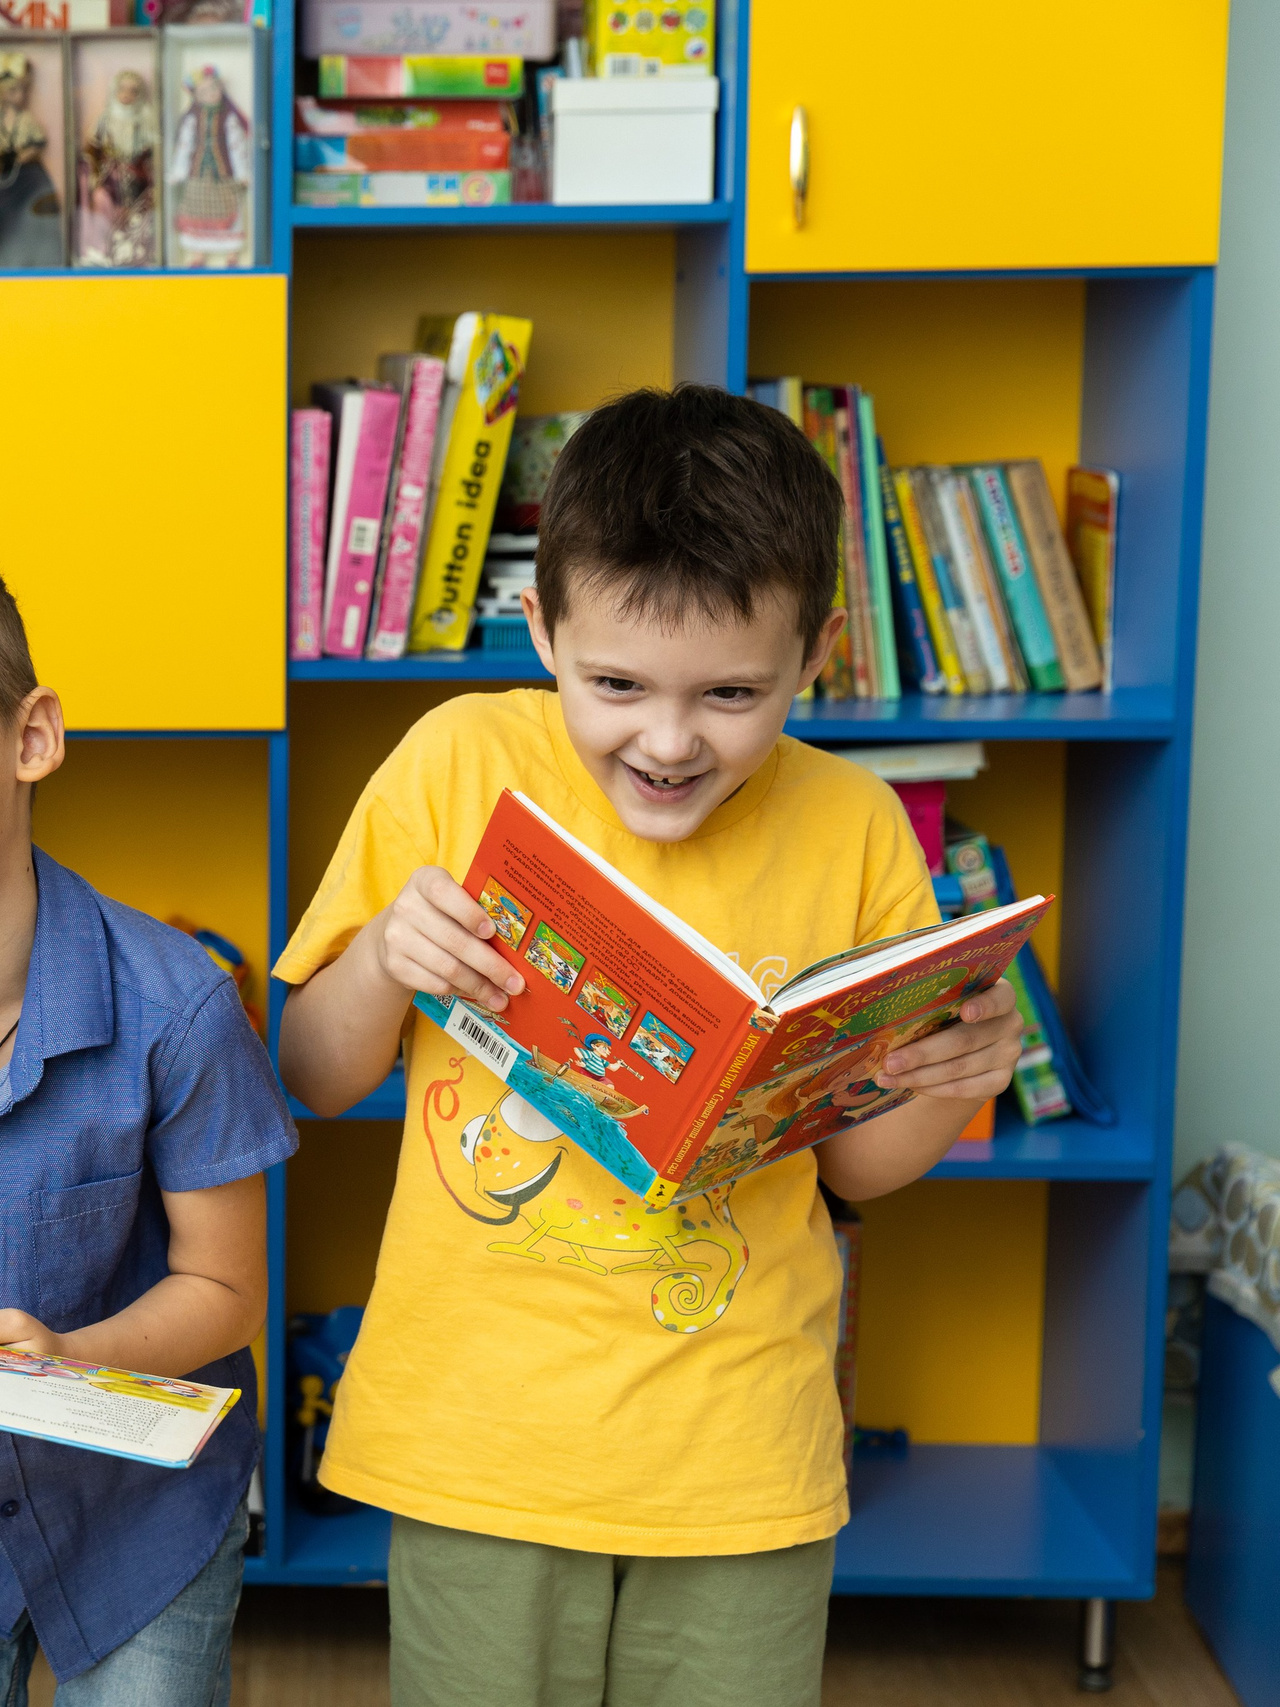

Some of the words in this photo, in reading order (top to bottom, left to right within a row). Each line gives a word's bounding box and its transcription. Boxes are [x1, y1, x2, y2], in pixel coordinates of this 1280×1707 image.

[426, 522, 473, 622] button
[456, 440, 491, 509] idea
[781, 940, 1014, 1055] Хрестоматия
[720, 1033, 760, 1090] ХРЕСТОМАТИЯ
[689, 1116, 707, 1140] группа
[700, 1092, 724, 1120] Старшая
